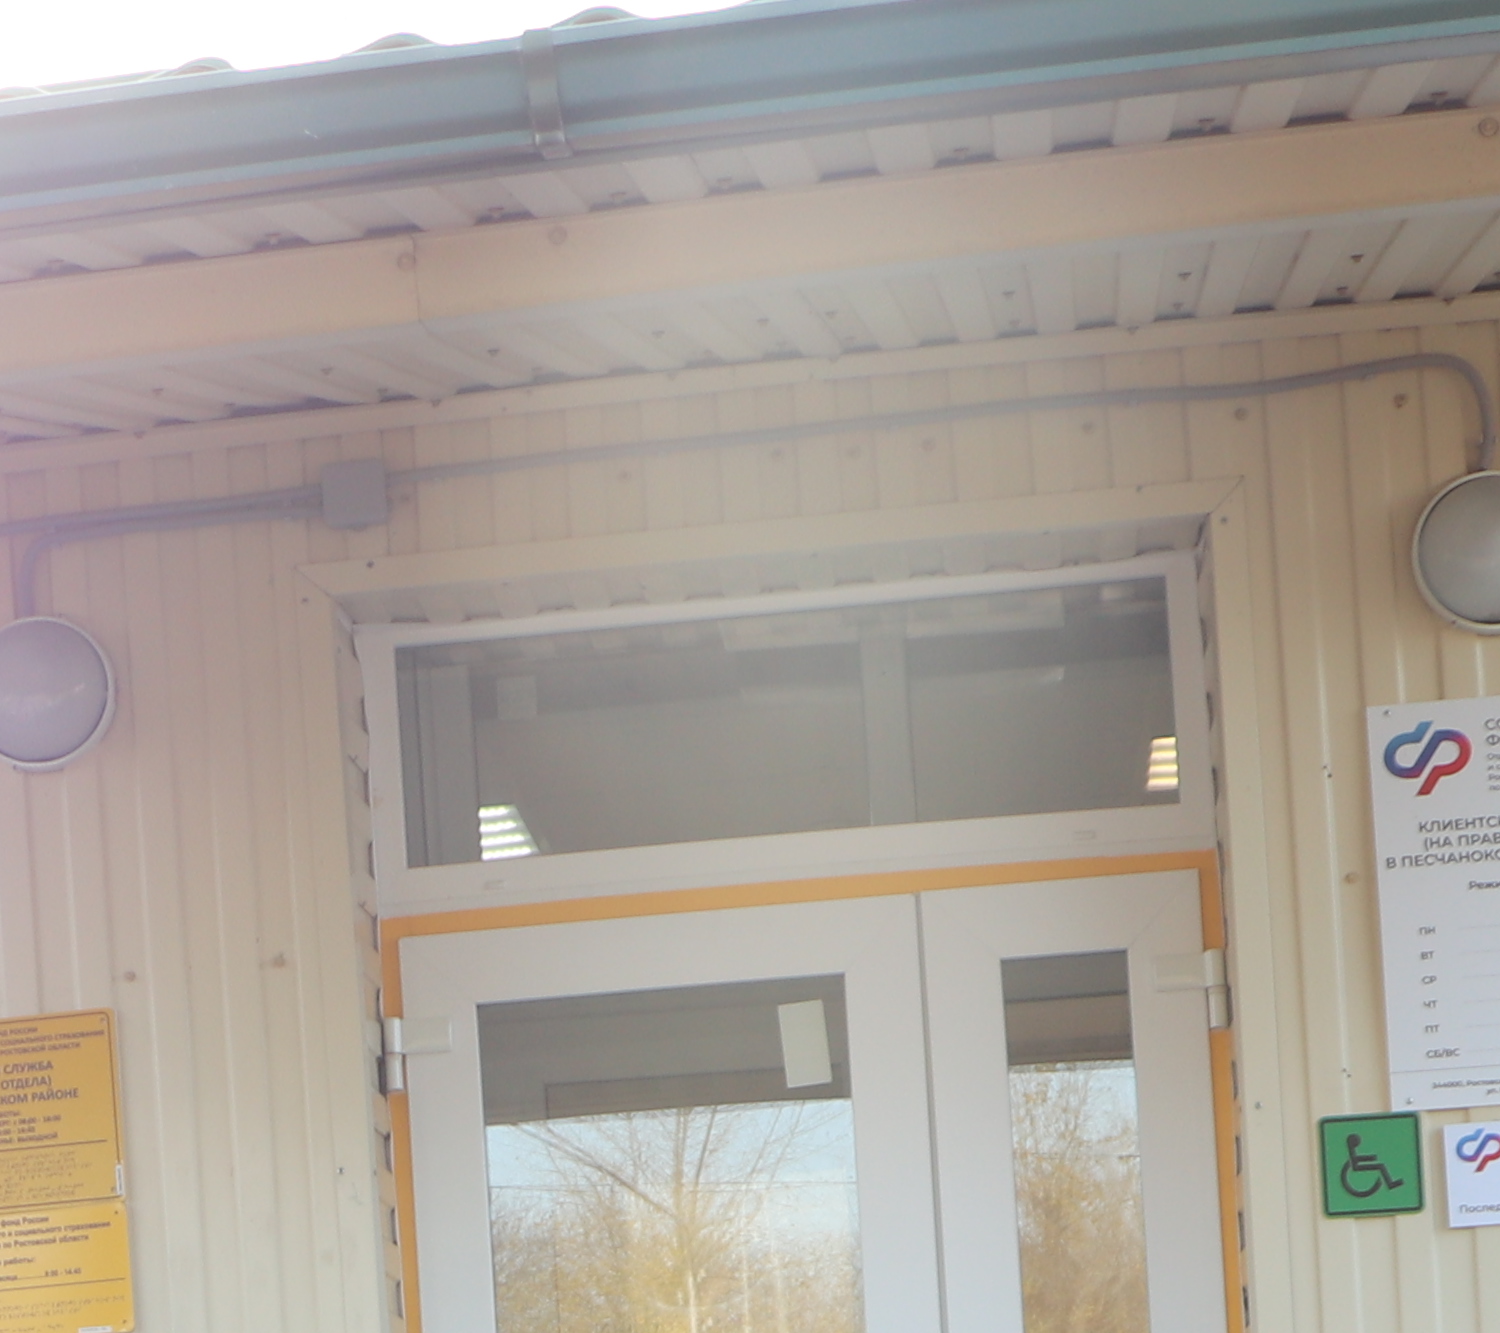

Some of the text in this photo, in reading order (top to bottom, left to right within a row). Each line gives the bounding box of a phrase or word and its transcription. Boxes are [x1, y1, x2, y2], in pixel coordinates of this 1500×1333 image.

[1424, 835, 1454, 852] (НА
[1386, 857, 1397, 869] В
[1419, 926, 1436, 935] ПН
[1420, 951, 1435, 960] ВТ
[1421, 975, 1438, 985] СР
[1423, 1000, 1438, 1009] ЧТ
[1425, 1024, 1440, 1034] ПТ
[3, 1061, 54, 1075] СЛУЖБА
[1, 1075, 52, 1090] ОТДЕЛА)
[31, 1087, 79, 1102] РАЙОНЕ
